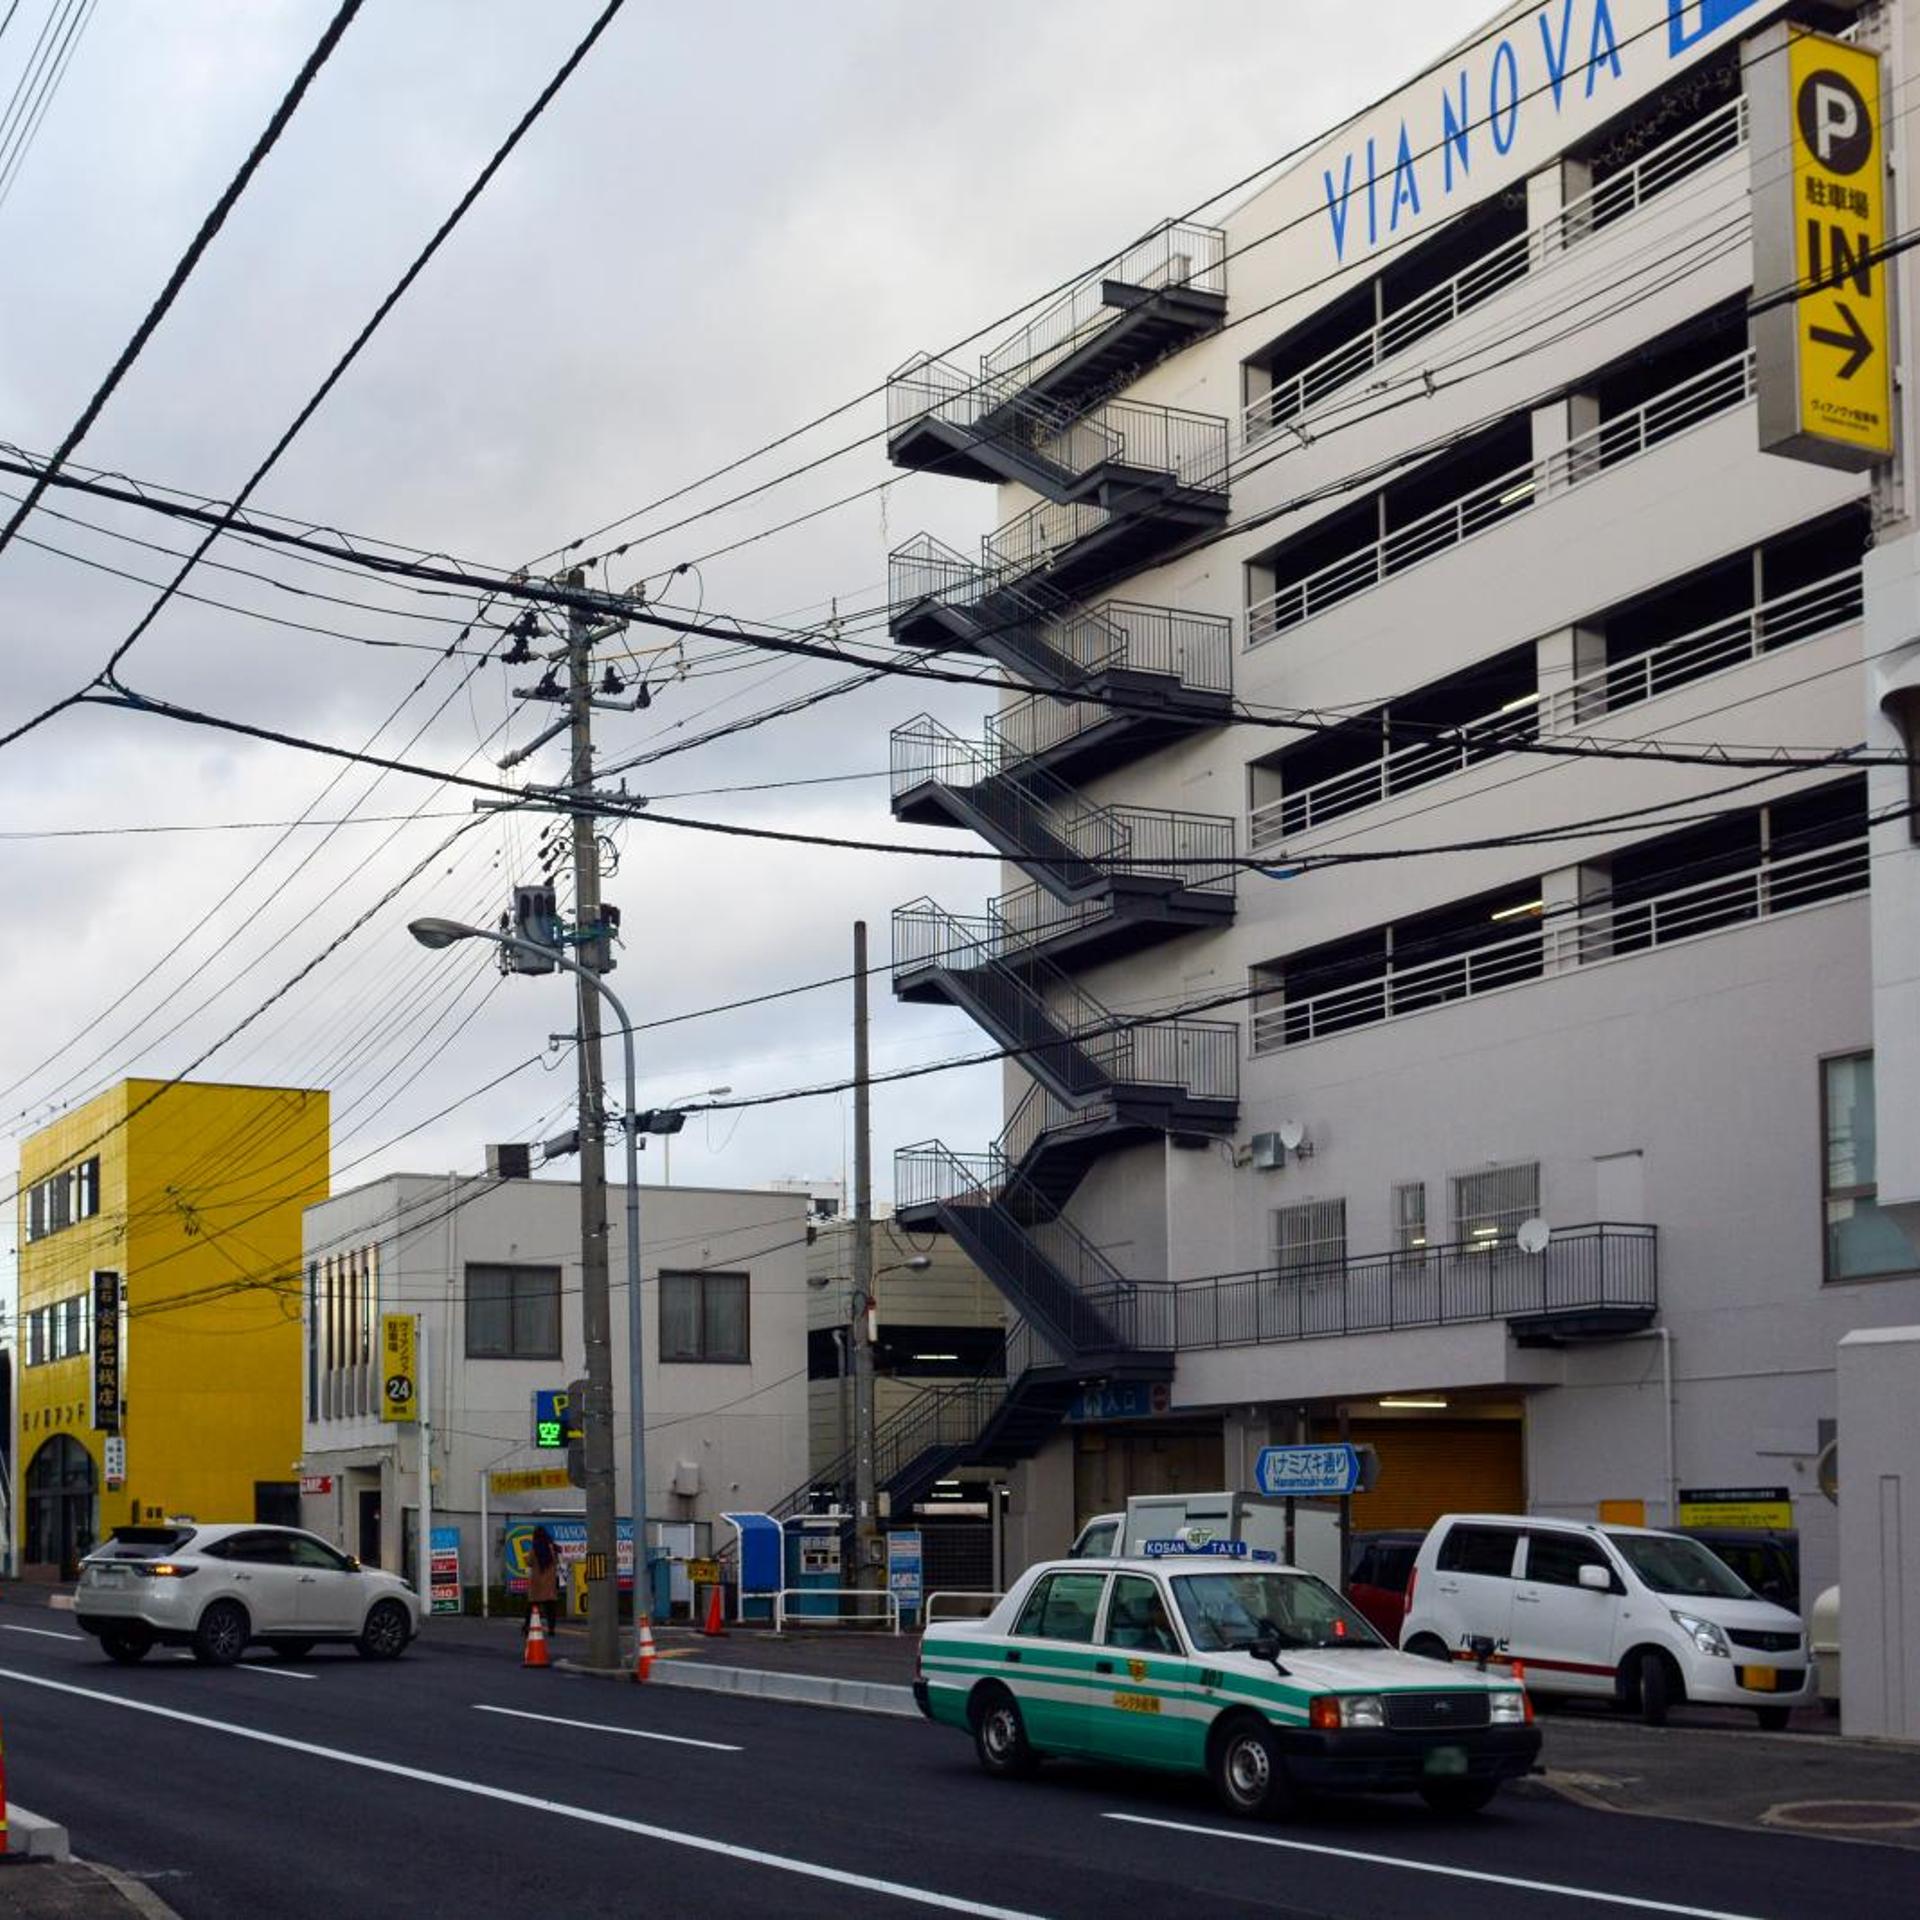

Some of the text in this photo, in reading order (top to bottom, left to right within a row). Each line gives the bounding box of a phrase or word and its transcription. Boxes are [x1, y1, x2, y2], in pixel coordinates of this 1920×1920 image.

[1323, 0, 1622, 262] VIANOVA
[1814, 83, 1858, 160] P
[1805, 175, 1869, 221] 駐車場
[1807, 218, 1871, 299] IN
[389, 1379, 410, 1400] 24
[552, 1394, 569, 1418] P
[538, 1422, 561, 1446] 空
[1266, 1452, 1347, 1475] ハナミズキ通り
[1273, 1476, 1339, 1488] Hanamizuki-dori
[1147, 1542, 1241, 1554] KOSAN TAXI
